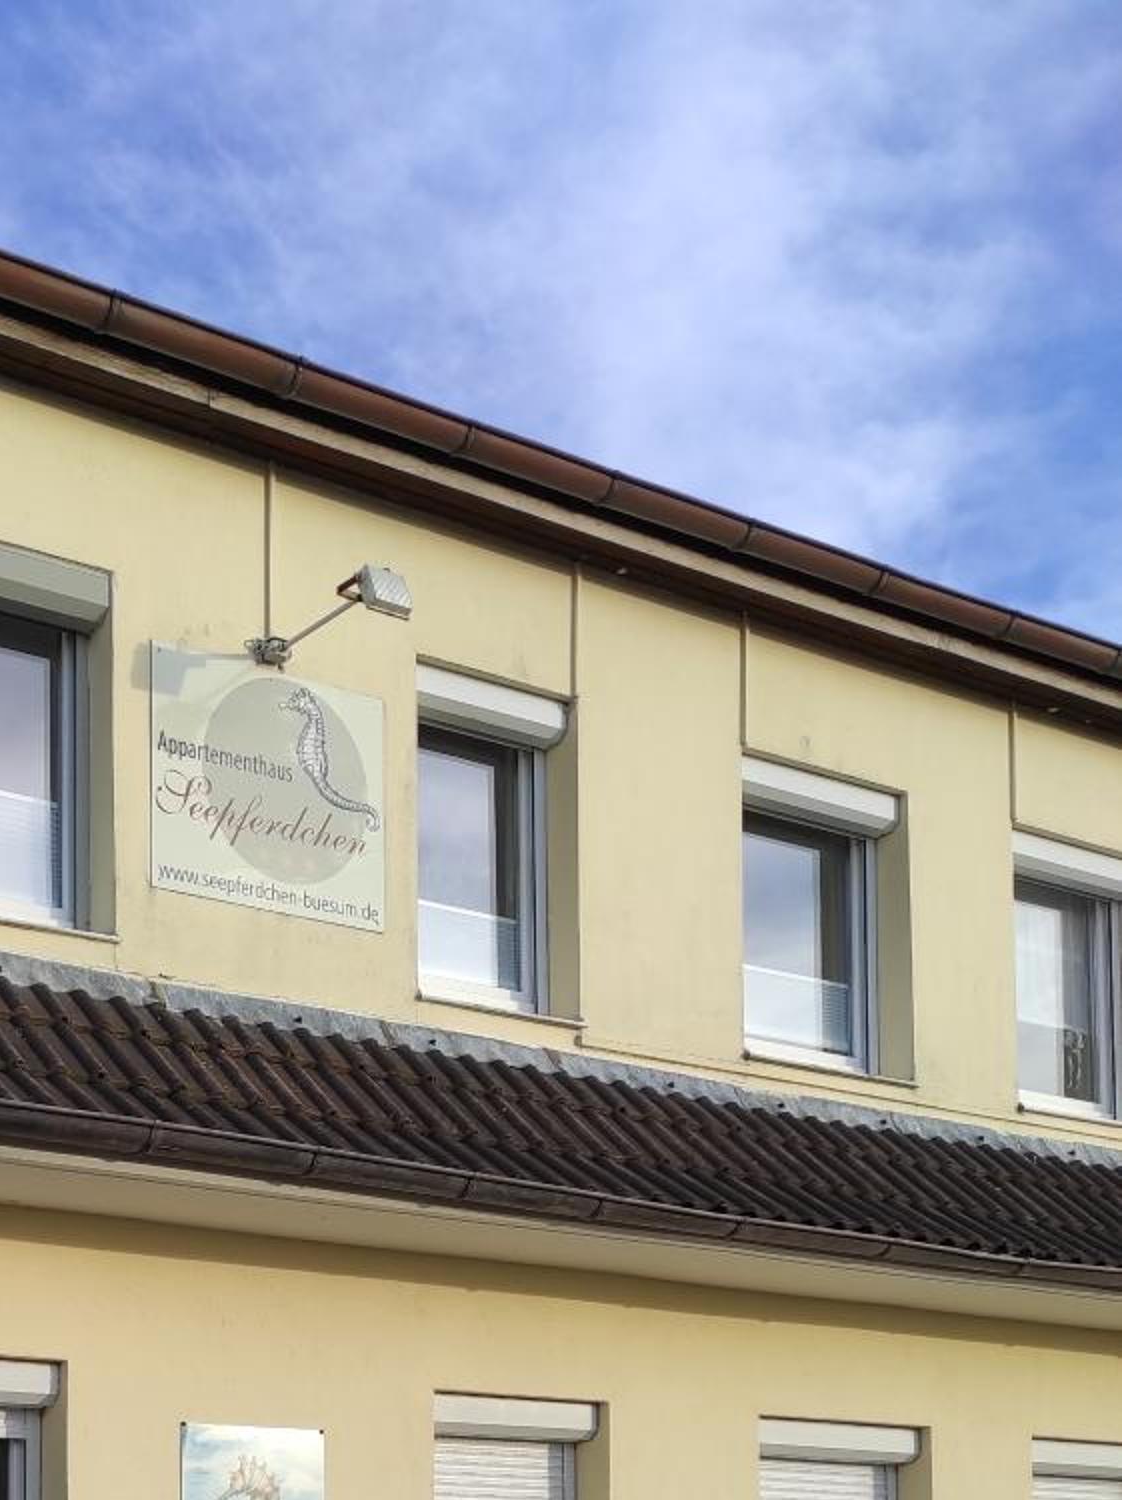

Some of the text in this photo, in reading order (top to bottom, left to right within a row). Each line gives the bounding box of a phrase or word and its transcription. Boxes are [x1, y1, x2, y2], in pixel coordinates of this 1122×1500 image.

[157, 731, 294, 783] Appartementhaus
[155, 769, 366, 856] Seepferdchen
[157, 863, 380, 922] www.seepferdchen-buesum.de
